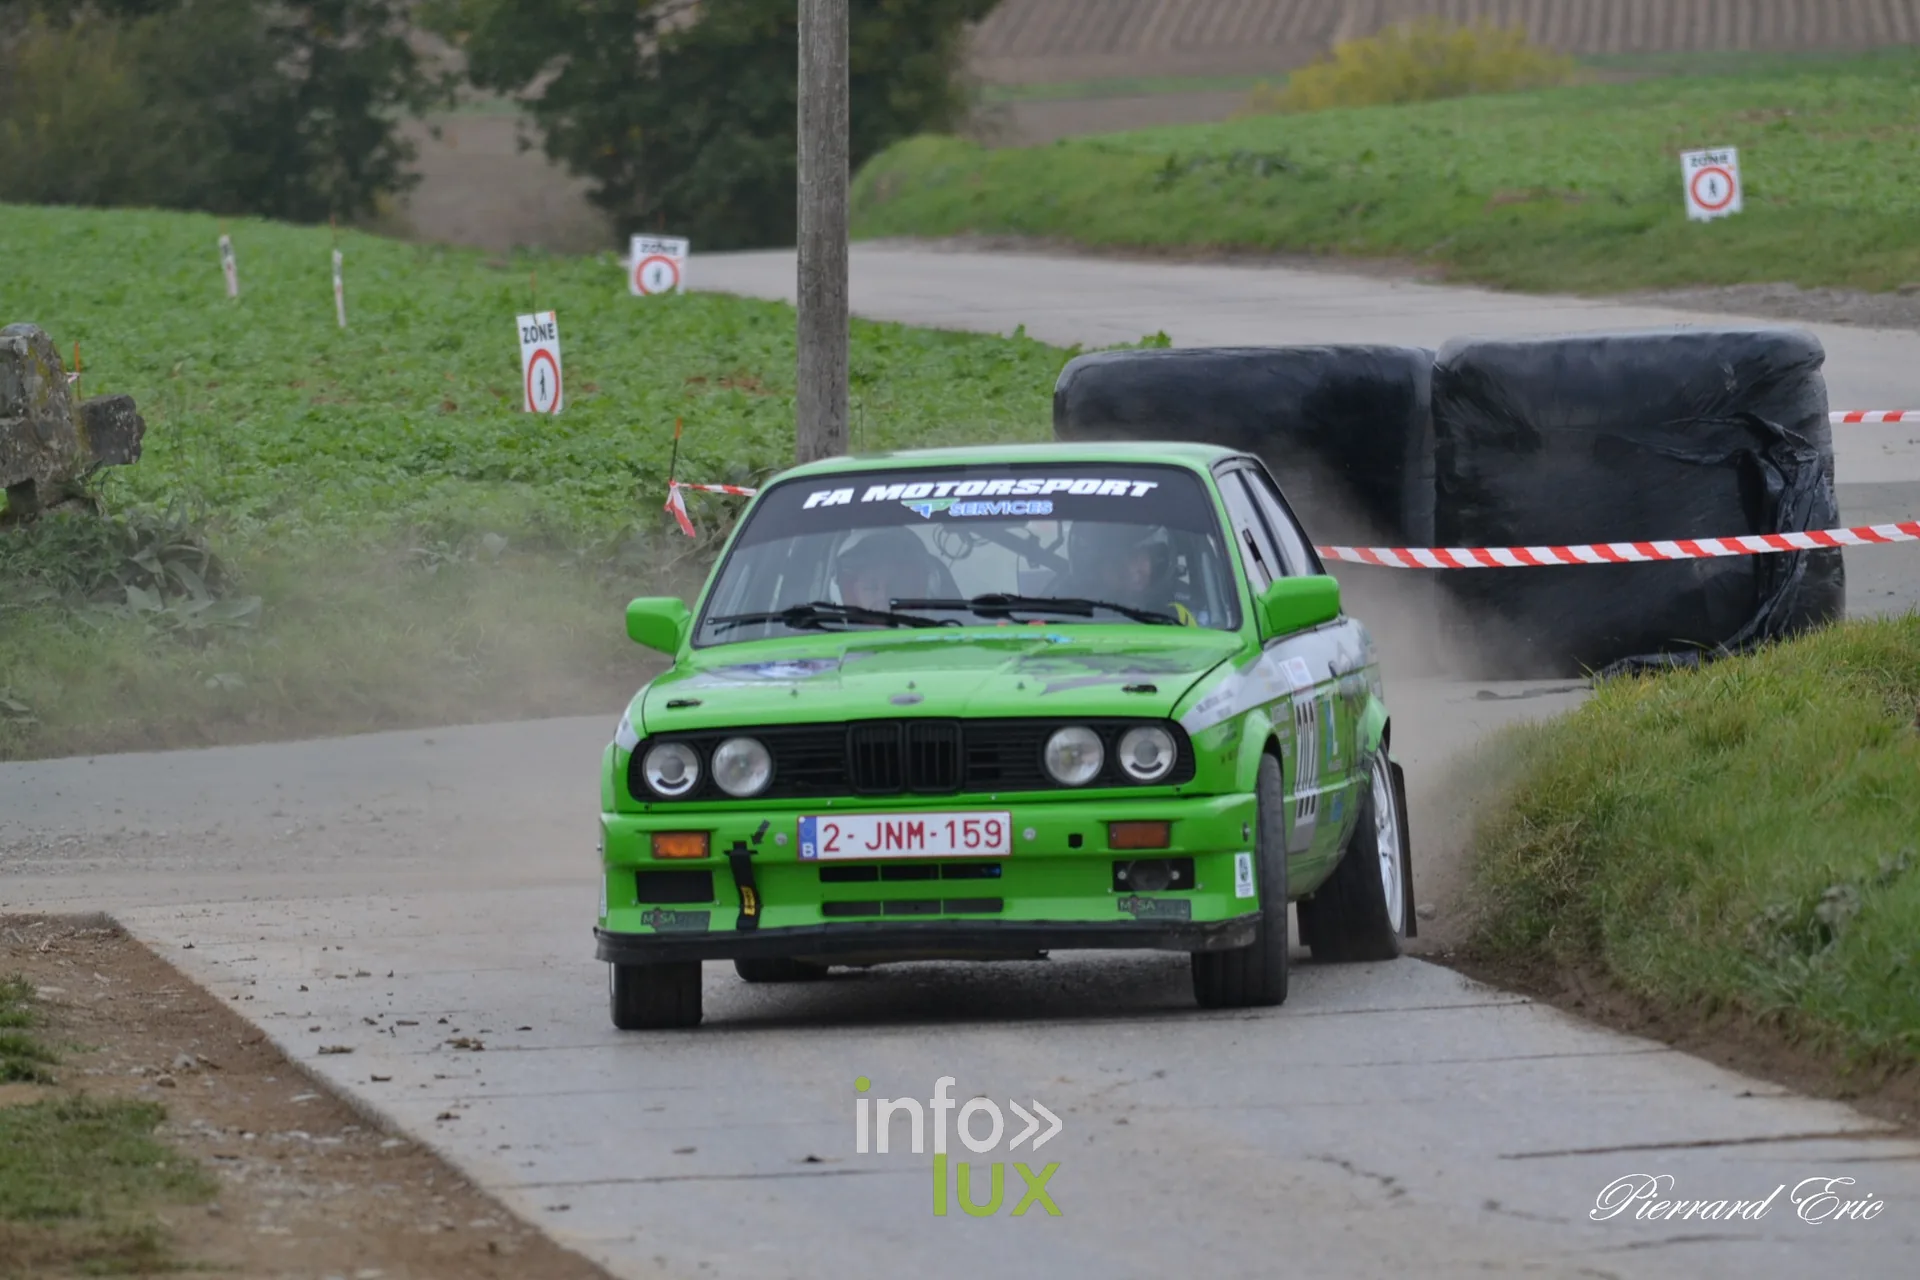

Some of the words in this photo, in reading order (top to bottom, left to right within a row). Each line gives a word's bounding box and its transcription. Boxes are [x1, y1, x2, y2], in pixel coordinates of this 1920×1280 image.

[521, 323, 556, 344] ZONE
[802, 488, 854, 509] FA
[861, 478, 1159, 502] MOTORSPORT
[948, 500, 1053, 517] SERVICES
[802, 842, 815, 858] B
